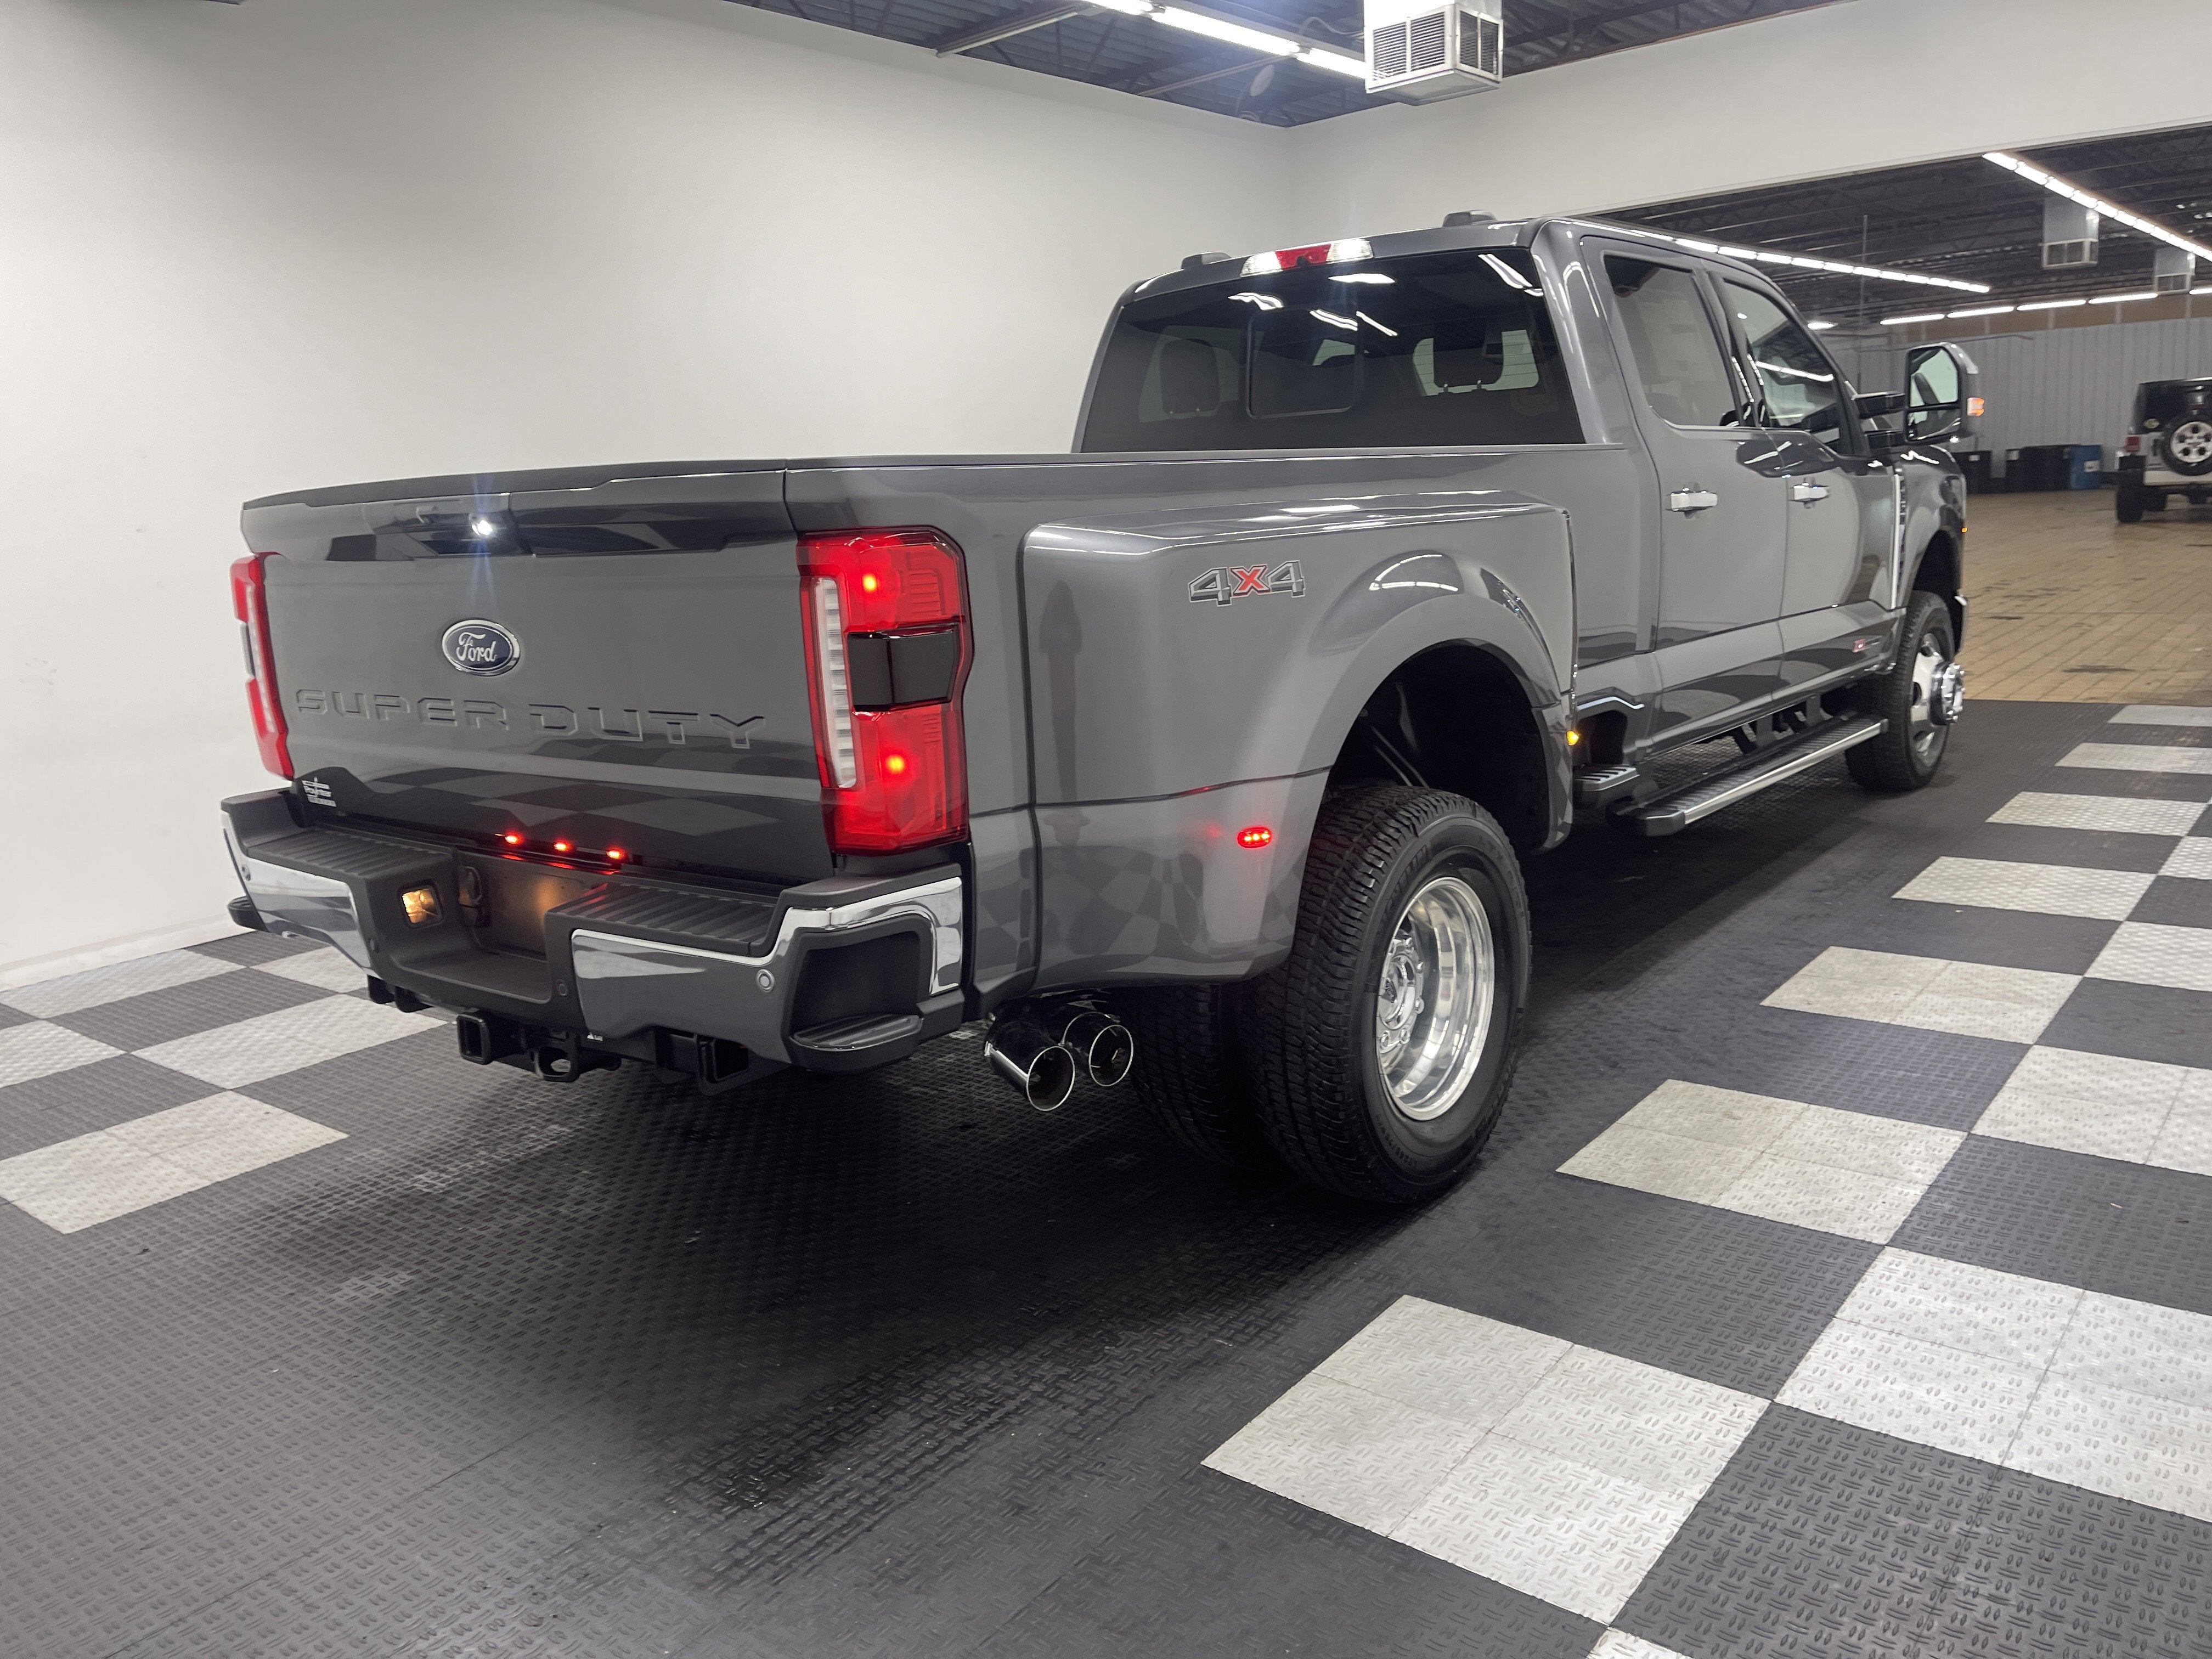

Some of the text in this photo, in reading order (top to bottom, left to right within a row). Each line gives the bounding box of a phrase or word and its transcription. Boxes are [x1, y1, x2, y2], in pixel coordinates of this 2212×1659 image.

[455, 631, 498, 662] Ford
[296, 688, 766, 749] SUPER DUTY
